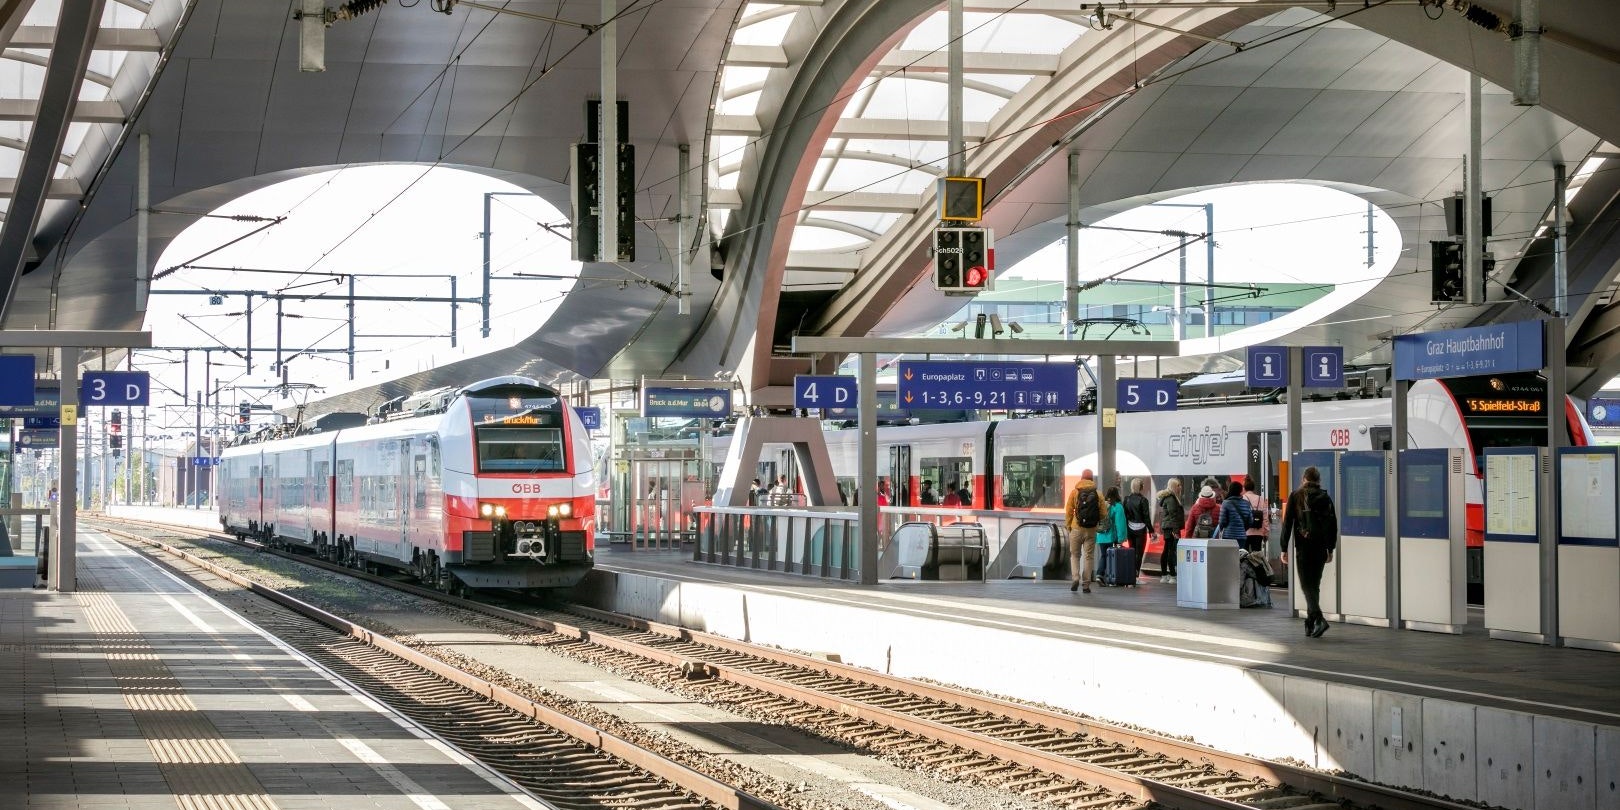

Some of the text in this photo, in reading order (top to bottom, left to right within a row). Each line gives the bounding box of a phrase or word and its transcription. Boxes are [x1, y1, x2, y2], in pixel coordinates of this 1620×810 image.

[1427, 332, 1505, 357] Graz Hauptbahnhof
[922, 373, 965, 381] Europaplatz
[91, 379, 141, 401] 3 D
[803, 382, 849, 403] 4 D
[1126, 385, 1169, 406] 5 D
[1479, 400, 1541, 412] Spielfeld-Straß
[1168, 425, 1229, 465] cityjet
[1331, 429, 1351, 447] ÖBB
[512, 483, 541, 494] ÖBB
